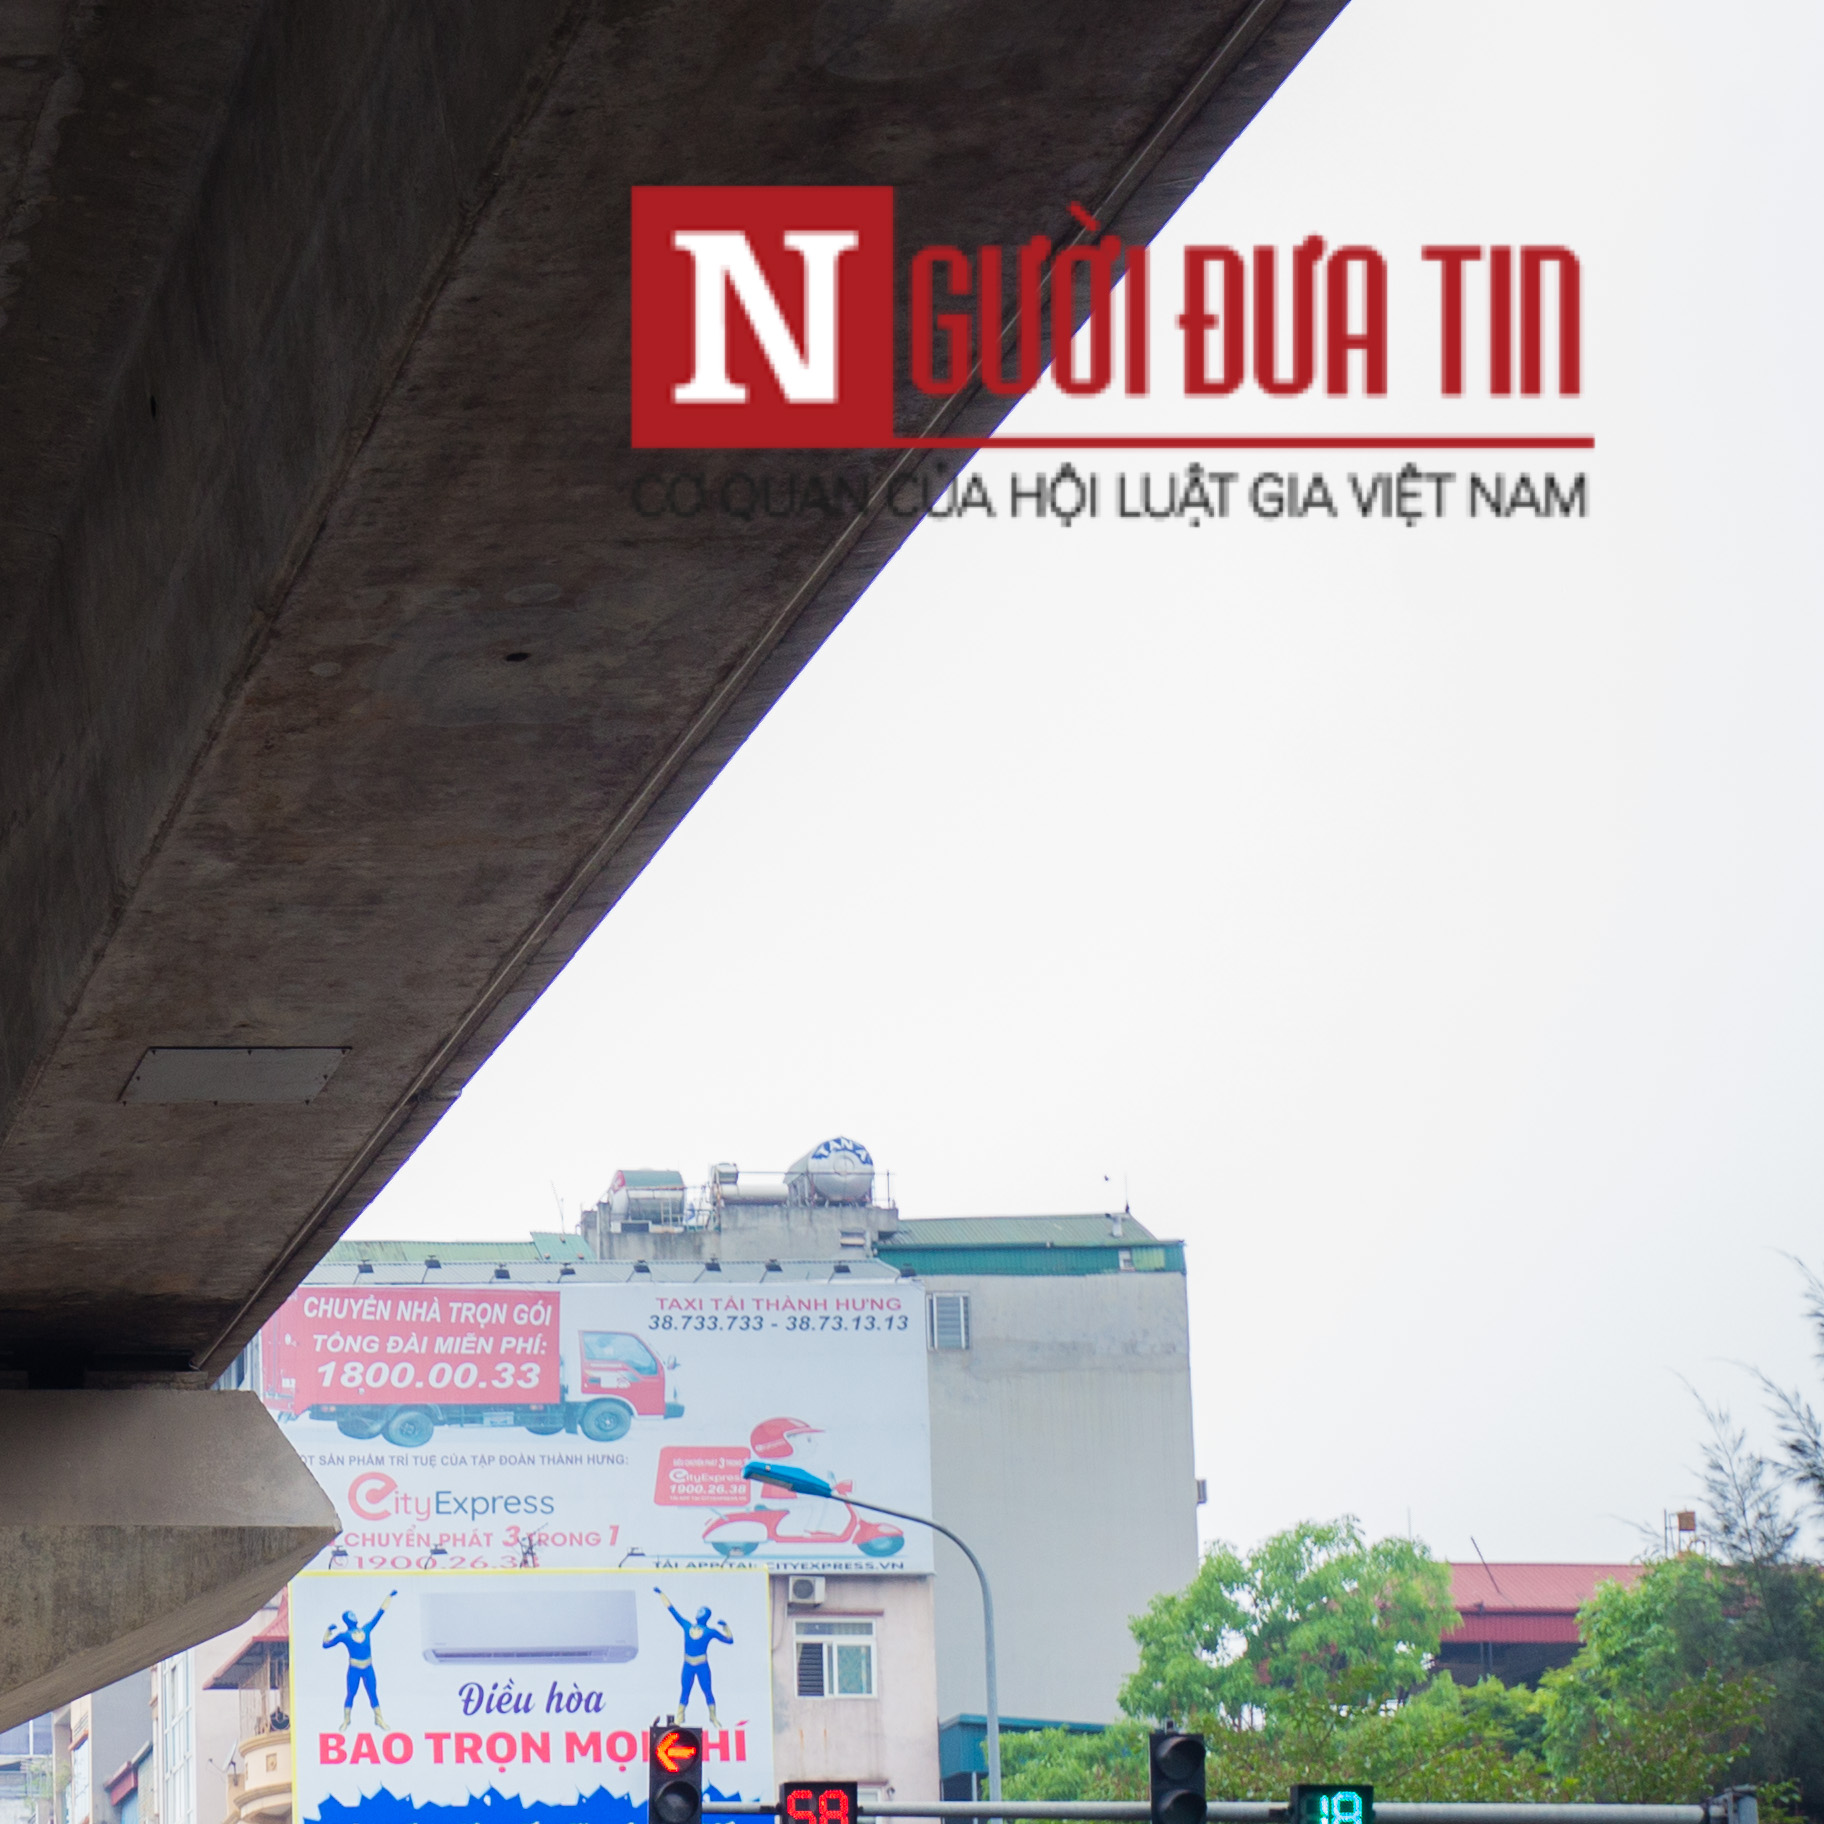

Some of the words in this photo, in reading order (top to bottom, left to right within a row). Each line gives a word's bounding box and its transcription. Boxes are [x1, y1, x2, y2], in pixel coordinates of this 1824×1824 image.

[304, 1295, 391, 1321] CHUYỂN
[398, 1297, 441, 1322] NHÀ
[450, 1302, 507, 1328] TRỌN
[513, 1299, 552, 1326] GÓI
[655, 1297, 703, 1311] TAXI
[710, 1294, 744, 1311] TẢI
[752, 1294, 827, 1311] THÀNH
[836, 1297, 901, 1311] HƯNG
[648, 1315, 764, 1331] 38.733.733
[785, 1315, 908, 1331] 38.73.13.13
[312, 1331, 379, 1352] TỔNG
[386, 1333, 428, 1353] ĐÀI
[434, 1332, 495, 1354] MIỄN
[500, 1333, 547, 1354] PHÍ:
[316, 1361, 541, 1388] 1800.00.33
[441, 1453, 467, 1466] CỦA
[470, 1453, 496, 1468] TẬP
[499, 1453, 537, 1466] ĐOÀN
[539, 1452, 585, 1465] THÀNH
[586, 1454, 629, 1465] HƯNG:
[347, 1471, 555, 1521] CityExpress
[670, 1484, 746, 1495] 1900.26.38
[344, 1524, 431, 1547] CHUYỂN
[439, 1529, 494, 1547] PHÁT
[503, 1525, 521, 1547] 3
[608, 1525, 620, 1547] 1
[459, 1679, 535, 1716] Điều
[546, 1680, 606, 1715] hòa
[319, 1731, 414, 1765] BAO
[425, 1732, 551, 1773] TRỌN
[701, 1719, 749, 1762] HÍ
